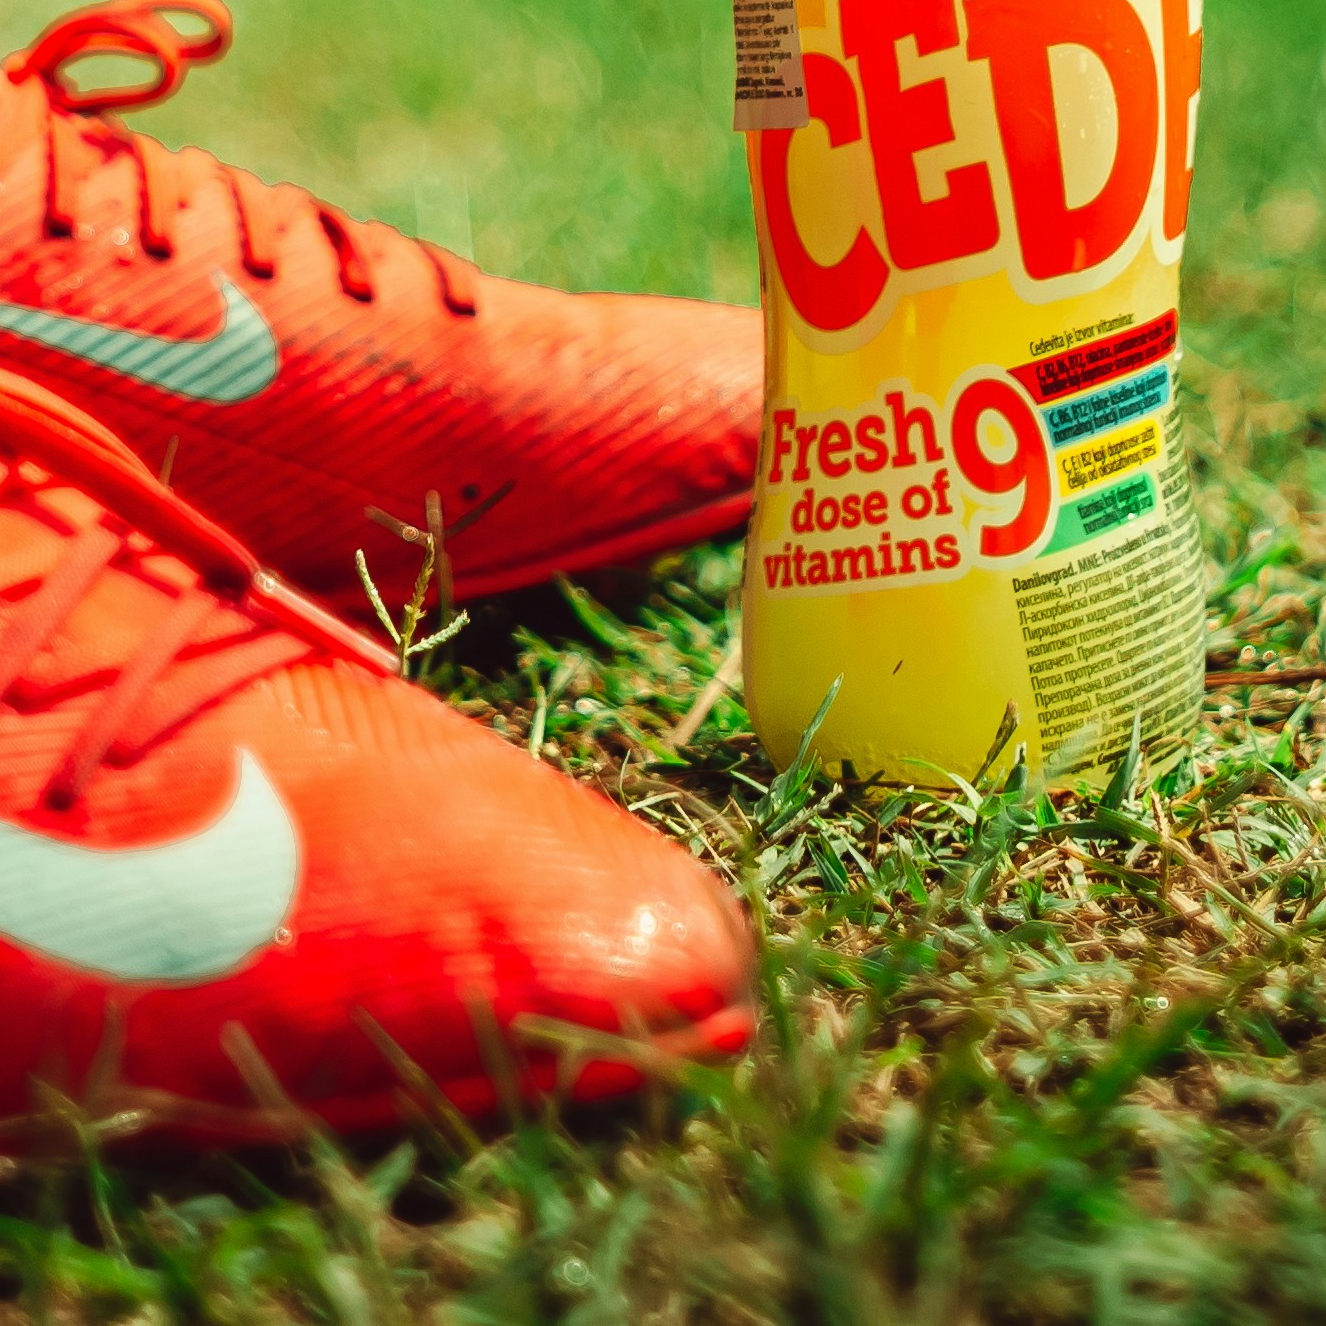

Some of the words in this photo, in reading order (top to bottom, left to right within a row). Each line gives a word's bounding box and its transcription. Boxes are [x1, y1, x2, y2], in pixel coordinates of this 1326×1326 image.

[769, 391, 944, 483] Fresh
[951, 378, 1052, 558] 9
[791, 488, 888, 533] dose
[901, 469, 953, 520] of
[764, 531, 962, 590] vitamins
